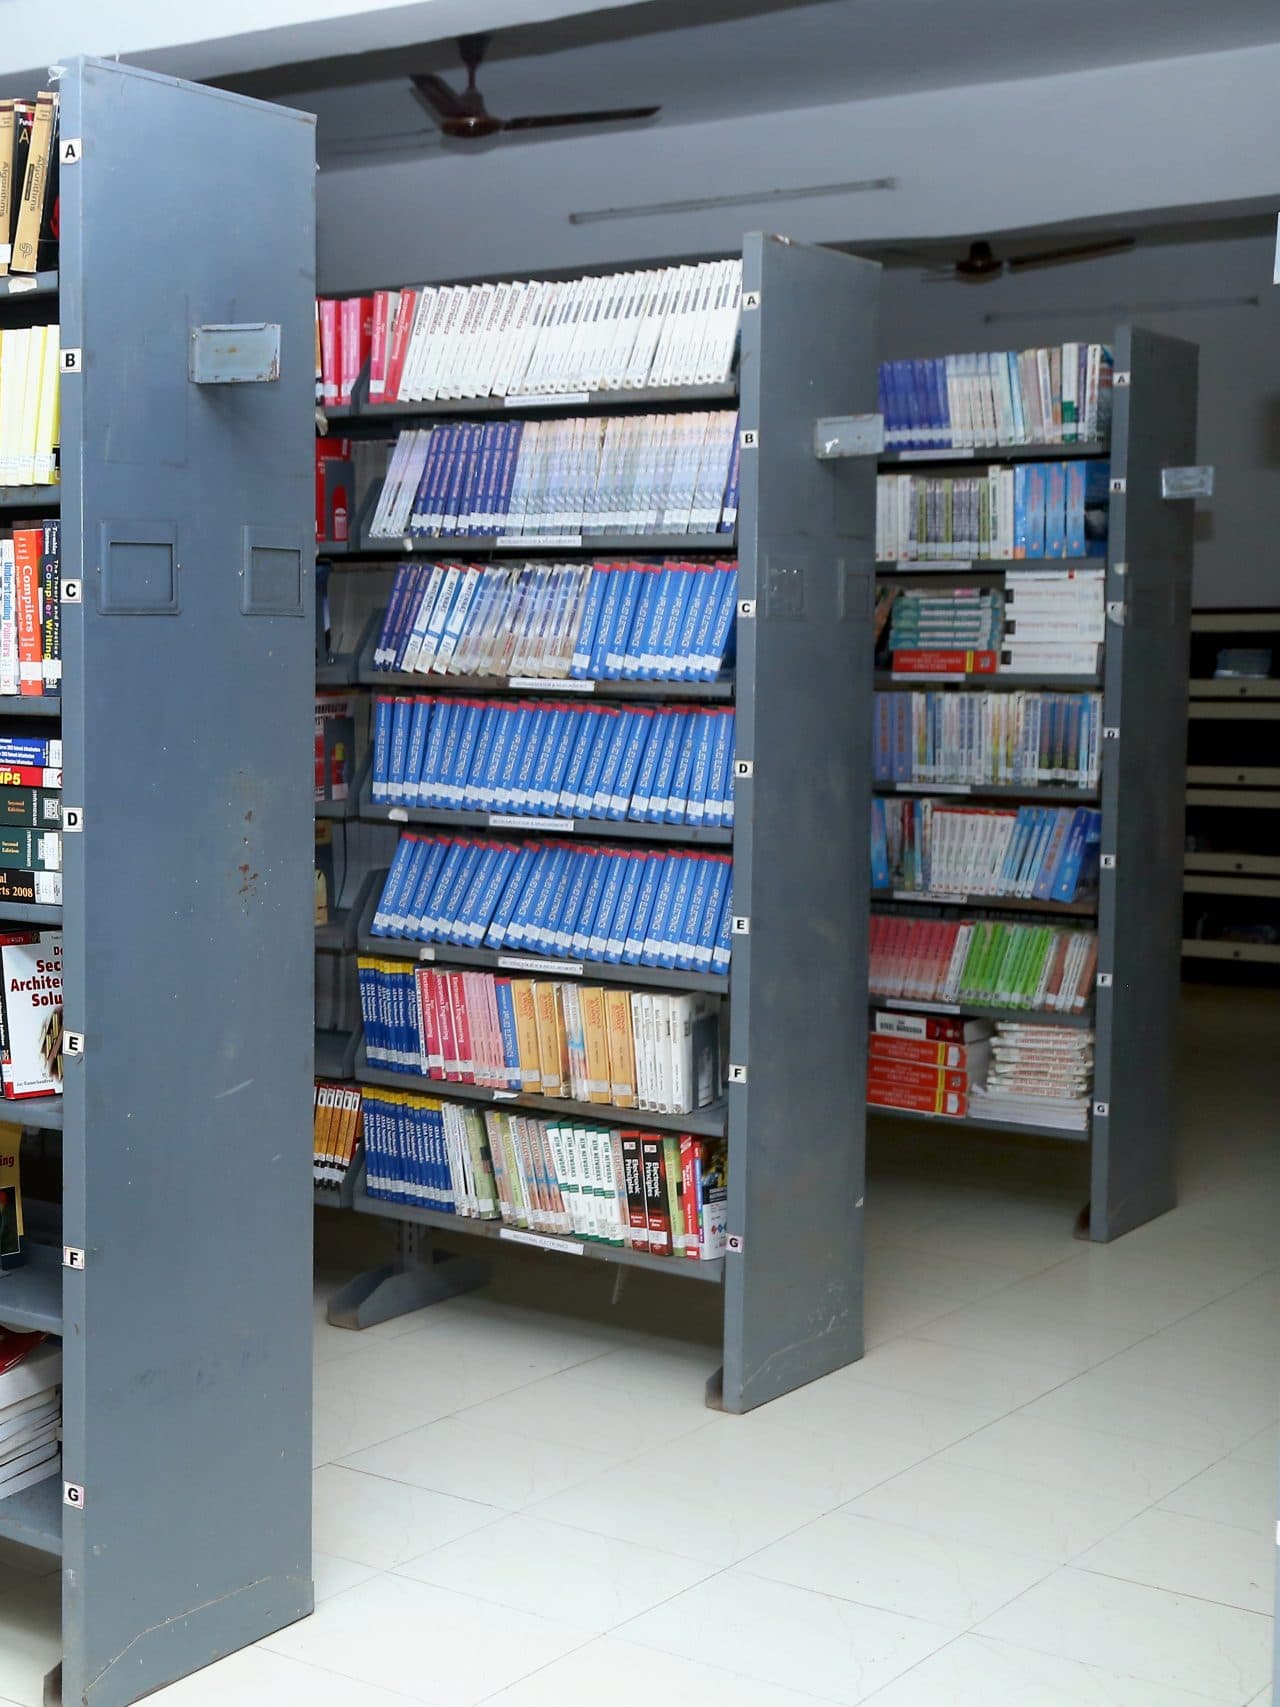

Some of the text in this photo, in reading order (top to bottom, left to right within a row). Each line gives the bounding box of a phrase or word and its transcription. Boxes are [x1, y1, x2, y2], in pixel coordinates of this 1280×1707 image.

[65, 144, 76, 158] A
[0, 161, 9, 217] Algorithms
[747, 295, 756, 305] A
[65, 353, 76, 368] B
[745, 433, 753, 443] B
[65, 583, 76, 597] C
[3, 562, 12, 657] Understanding Pointers
[741, 603, 750, 613] C
[739, 763, 748, 774] D
[67, 812, 78, 826] D
[13, 886, 33, 898] 2008
[737, 919, 745, 930] E
[68, 1036, 78, 1051] E
[734, 1068, 742, 1078] F
[555, 1151, 567, 1177] NETWORKS
[581, 1152, 590, 1179] NETWORKS
[594, 1154, 602, 1181] NETWORKS
[604, 1155, 612, 1184] NETWORKS
[626, 1159, 634, 1194] Principles
[631, 1159, 641, 1194] Electronic
[645, 1162, 653, 1197] Principles
[652, 1162, 660, 1197] Electronic
[729, 1237, 739, 1248] G
[69, 1252, 79, 1265] F
[67, 1488, 79, 1501] G
